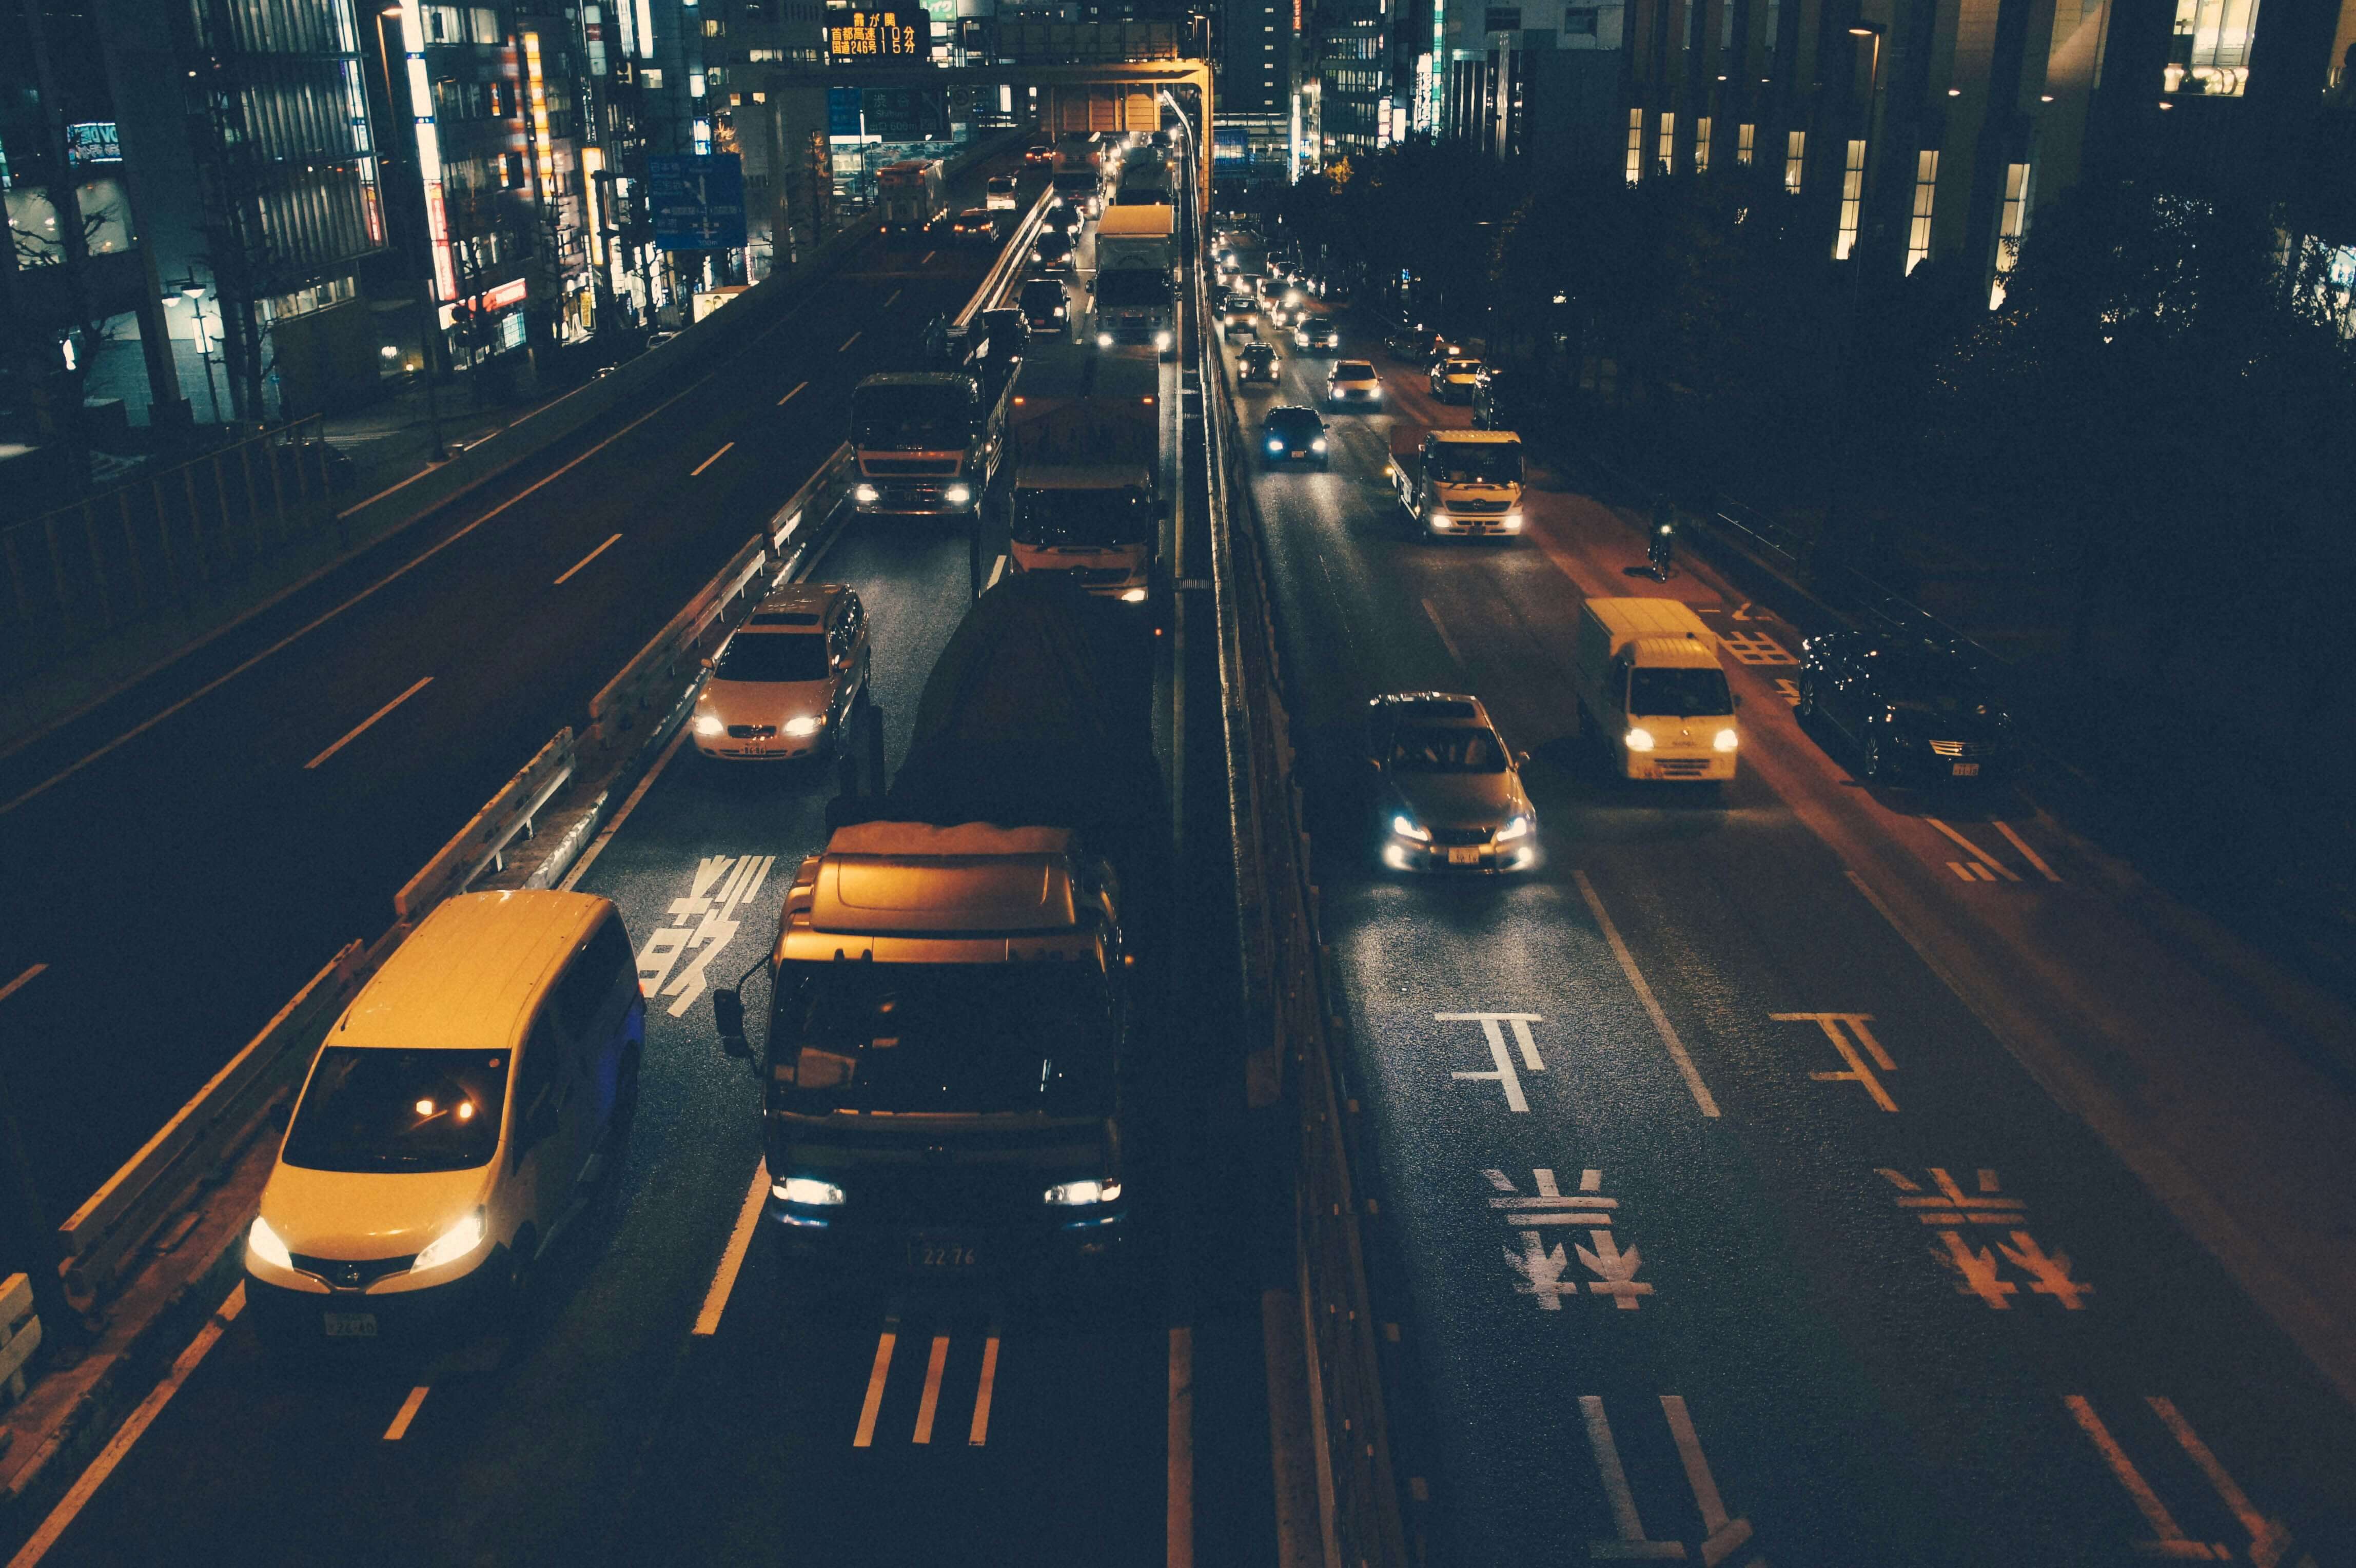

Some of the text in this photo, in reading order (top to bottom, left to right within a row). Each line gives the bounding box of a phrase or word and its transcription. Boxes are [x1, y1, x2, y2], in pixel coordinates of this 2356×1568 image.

[831, 27, 876, 41] 首都高速
[832, 41, 877, 54] 国道246号
